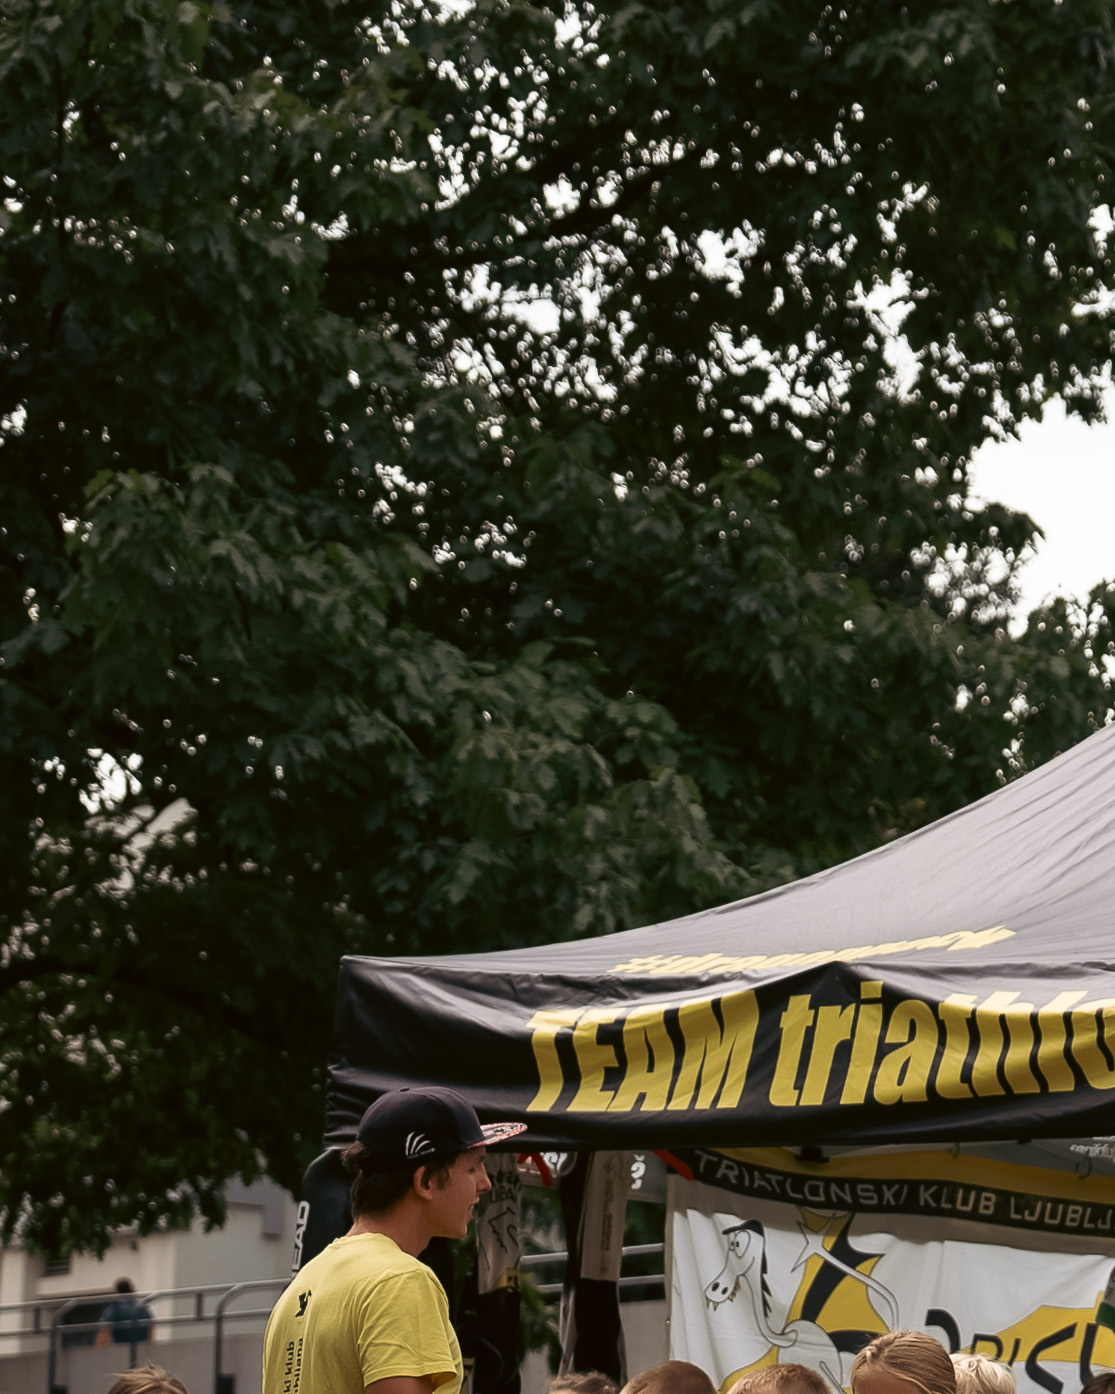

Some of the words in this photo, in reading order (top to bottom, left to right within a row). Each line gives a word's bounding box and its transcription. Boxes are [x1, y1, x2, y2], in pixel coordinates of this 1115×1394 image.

[525, 989, 760, 1112] TEAM
[694, 1149, 908, 1206] TRIATLONSKI
[919, 1185, 995, 1215] KLUB
[292, 1200, 310, 1278] EAD
[284, 1340, 295, 1376] klub
